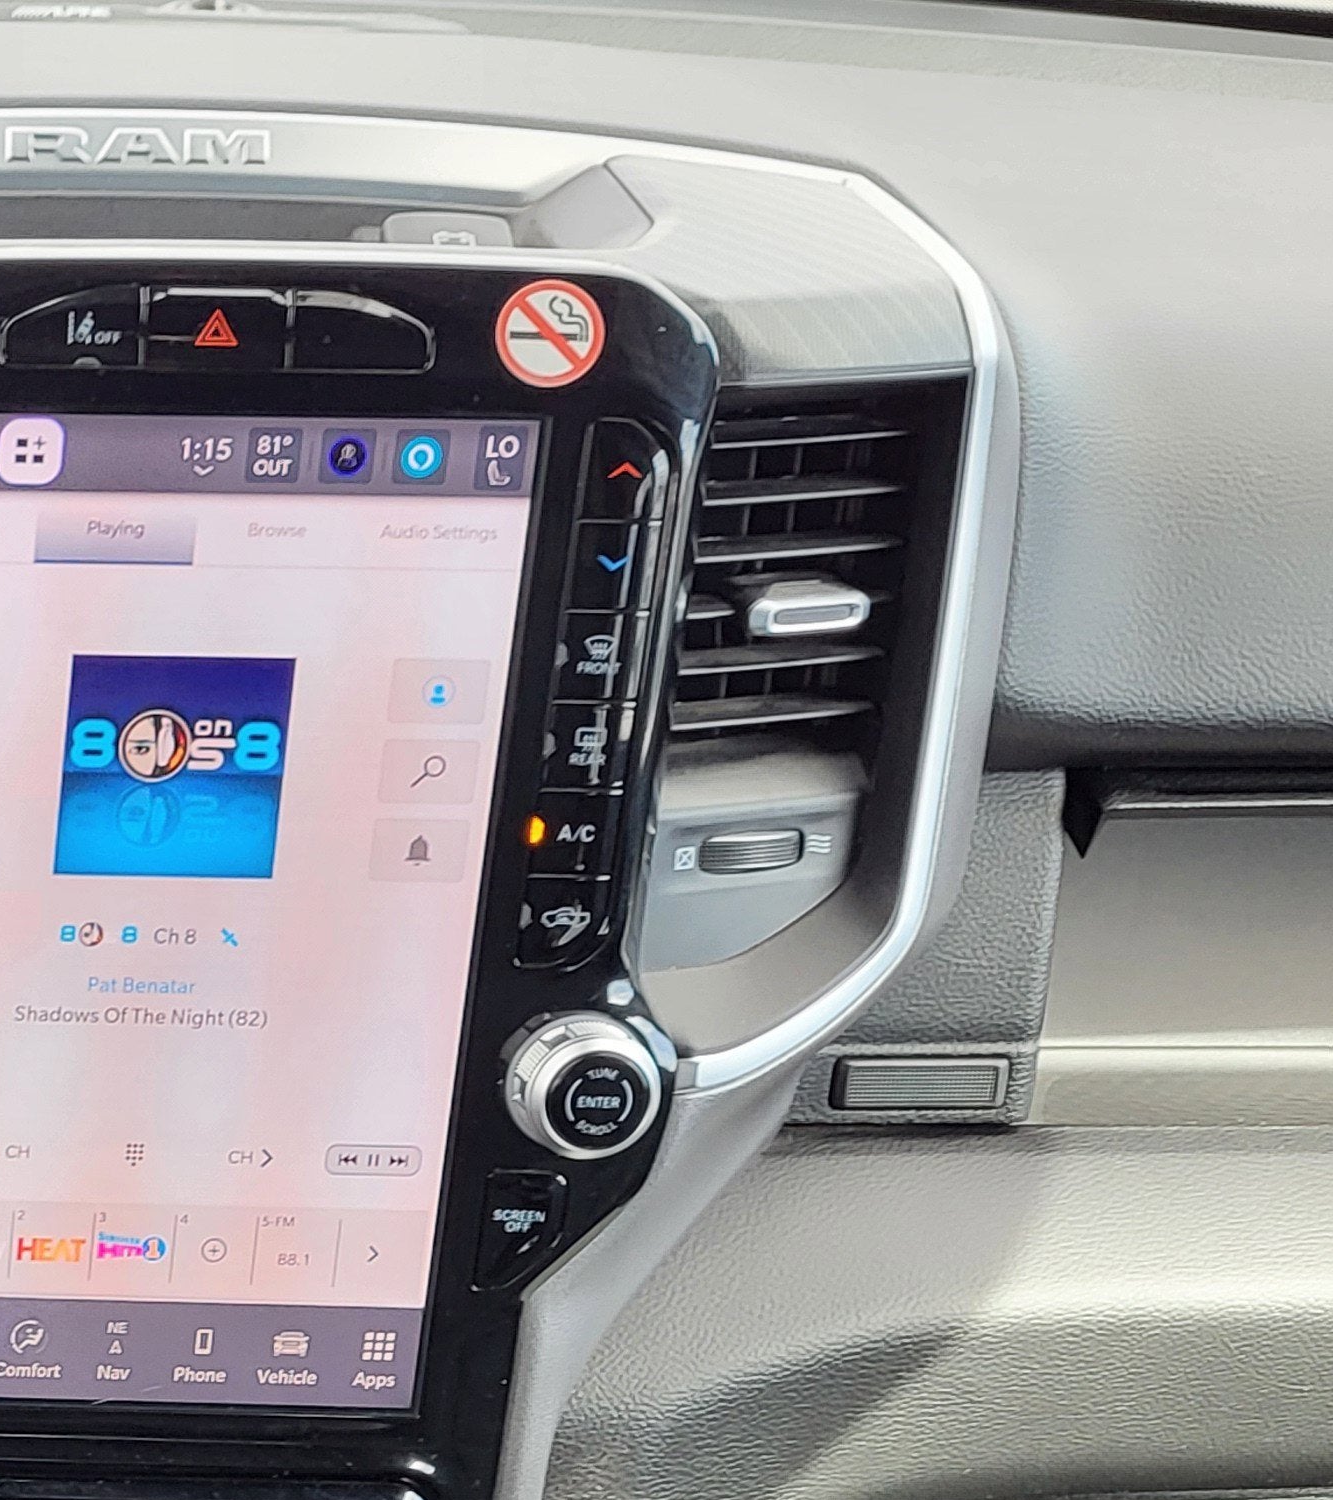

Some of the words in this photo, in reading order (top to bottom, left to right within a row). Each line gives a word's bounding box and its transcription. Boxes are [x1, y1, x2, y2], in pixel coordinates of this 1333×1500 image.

[4, 126, 272, 165] RAM
[181, 437, 233, 462] 1:15
[256, 434, 293, 456] 81°
[485, 435, 521, 458] LO
[253, 458, 293, 477] OUT
[87, 520, 146, 540] Playing
[247, 523, 307, 539] Browse
[380, 525, 429, 541] Audio
[432, 525, 498, 543] Settings
[576, 659, 622, 676] FRONT
[194, 718, 233, 736] on
[234, 721, 282, 771] 8
[568, 750, 607, 767] REAR
[556, 824, 596, 843] A/C
[153, 926, 180, 945] Ch
[184, 928, 197, 945] 8
[87, 977, 117, 995] Pat
[122, 977, 196, 996] Benatar
[14, 1005, 100, 1026] Shadows
[104, 1006, 129, 1026] Of
[132, 1007, 166, 1027] The
[170, 1008, 225, 1031] Night
[228, 1008, 268, 1030] (82)
[575, 1095, 622, 1110] ENTER
[4, 1145, 31, 1161] CH
[228, 1149, 254, 1166] CH
[492, 1208, 547, 1224] SCREEN
[503, 1220, 531, 1234] OFF
[16, 1237, 86, 1262] HEAT
[277, 1253, 310, 1267] 88.1
[96, 1365, 131, 1381] Nav
[173, 1366, 228, 1384] Phone
[257, 1369, 318, 1386] Vehicle
[351, 1371, 396, 1390] Apps
